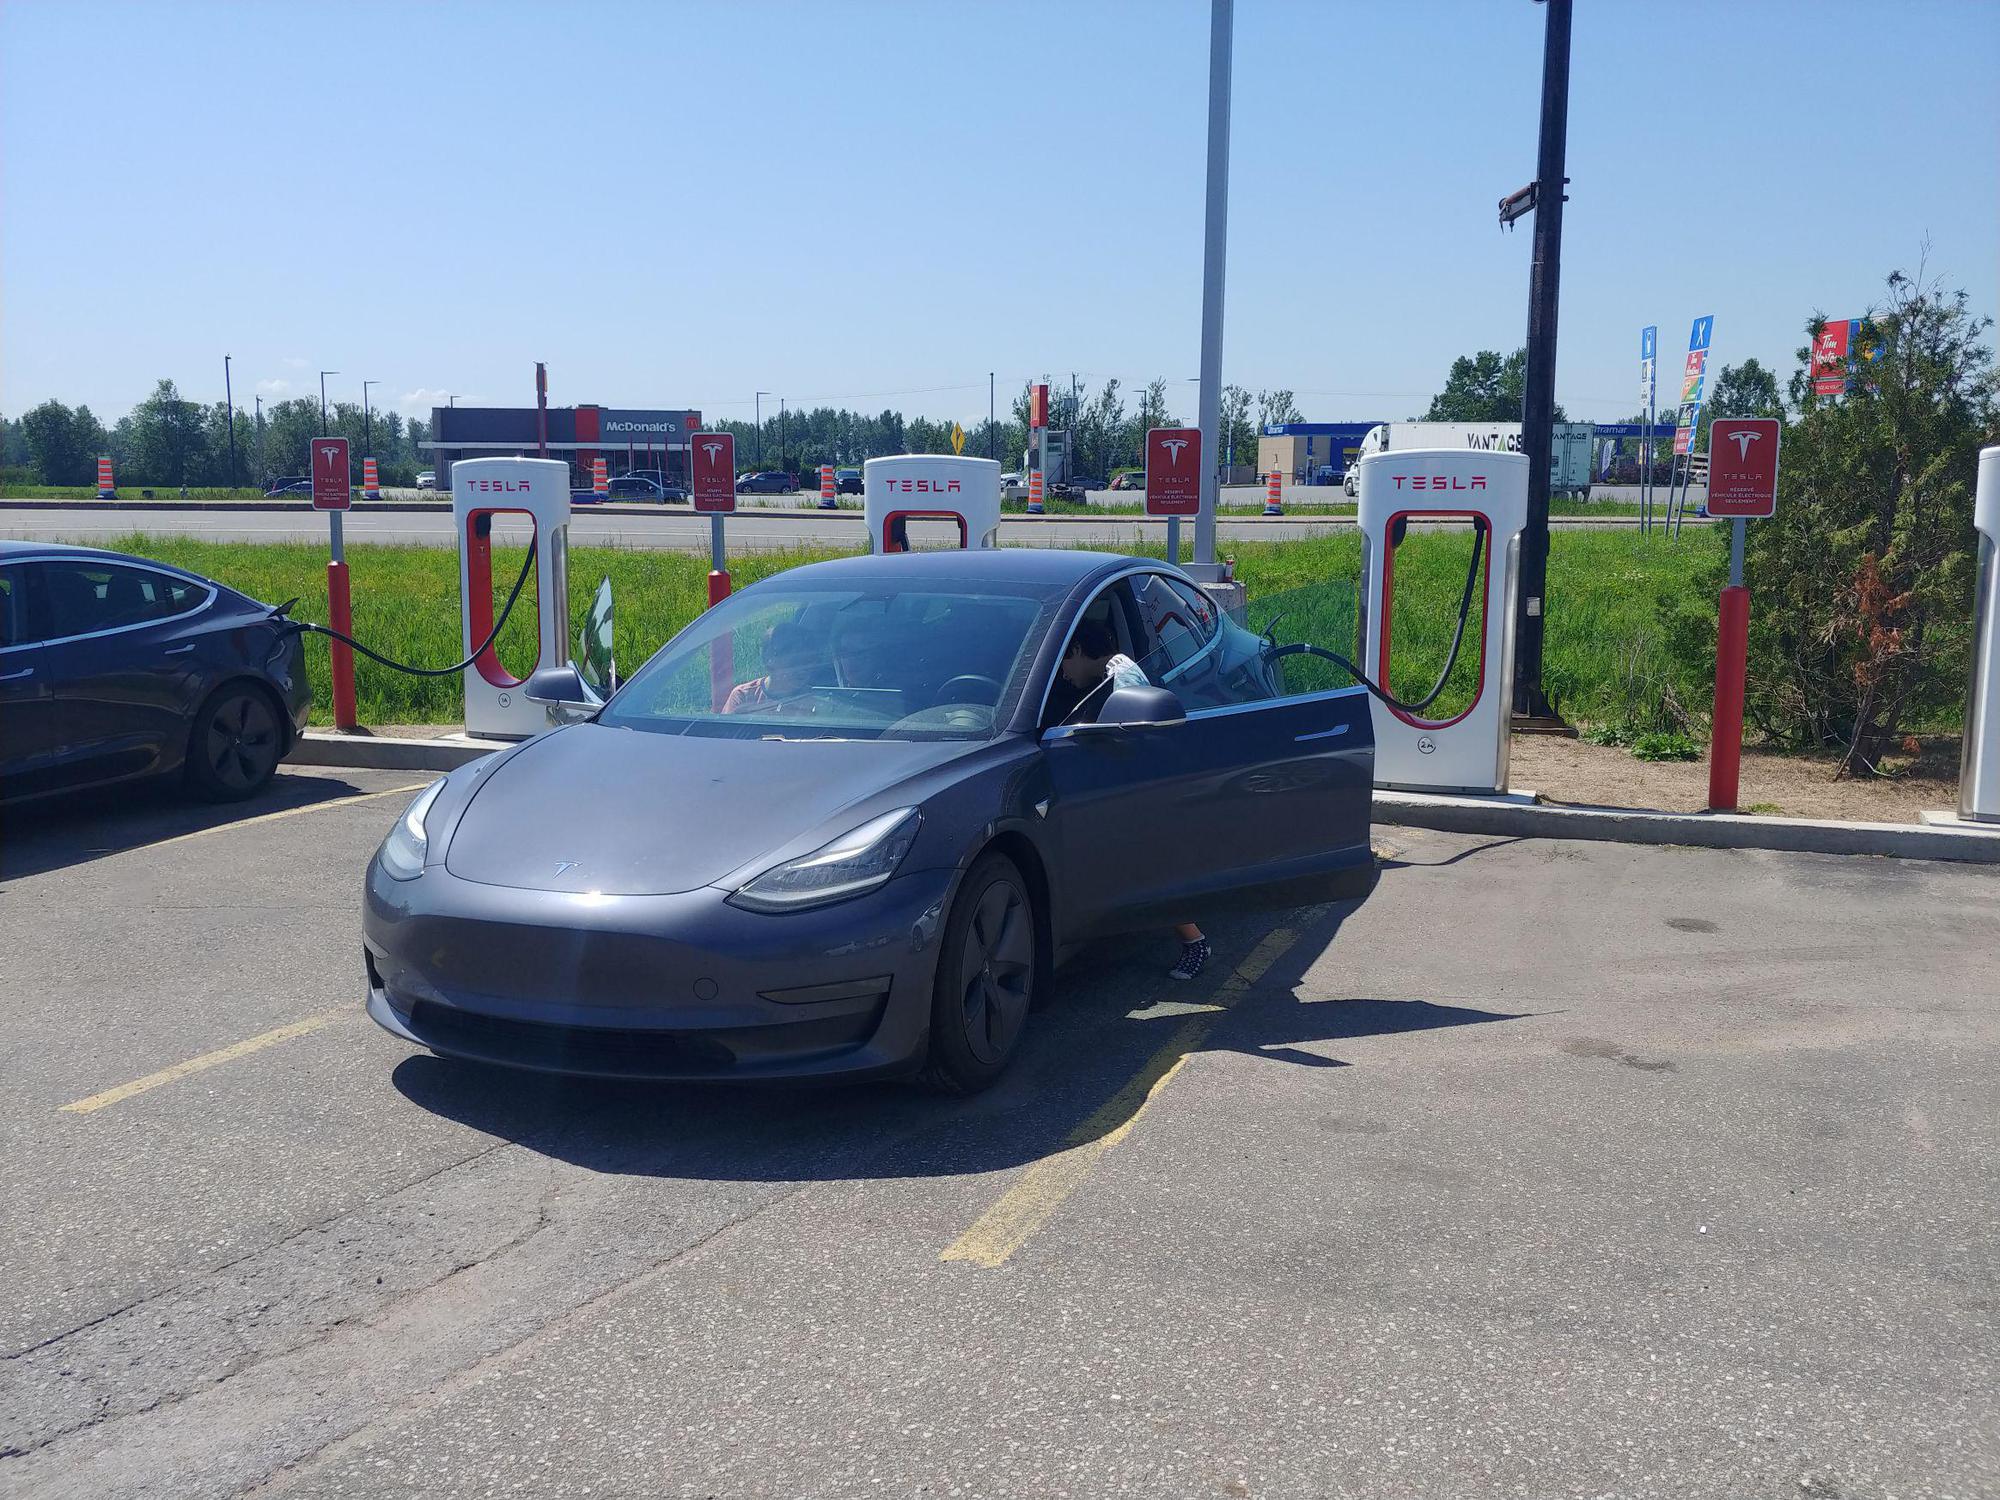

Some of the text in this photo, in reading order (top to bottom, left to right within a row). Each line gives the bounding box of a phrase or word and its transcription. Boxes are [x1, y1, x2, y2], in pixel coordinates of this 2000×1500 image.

[1822, 334, 1837, 350] Tim
[606, 421, 676, 432] McDonald's
[467, 480, 530, 492] TESLA
[886, 480, 961, 492] TESLA
[1391, 476, 1487, 490] TESLA
